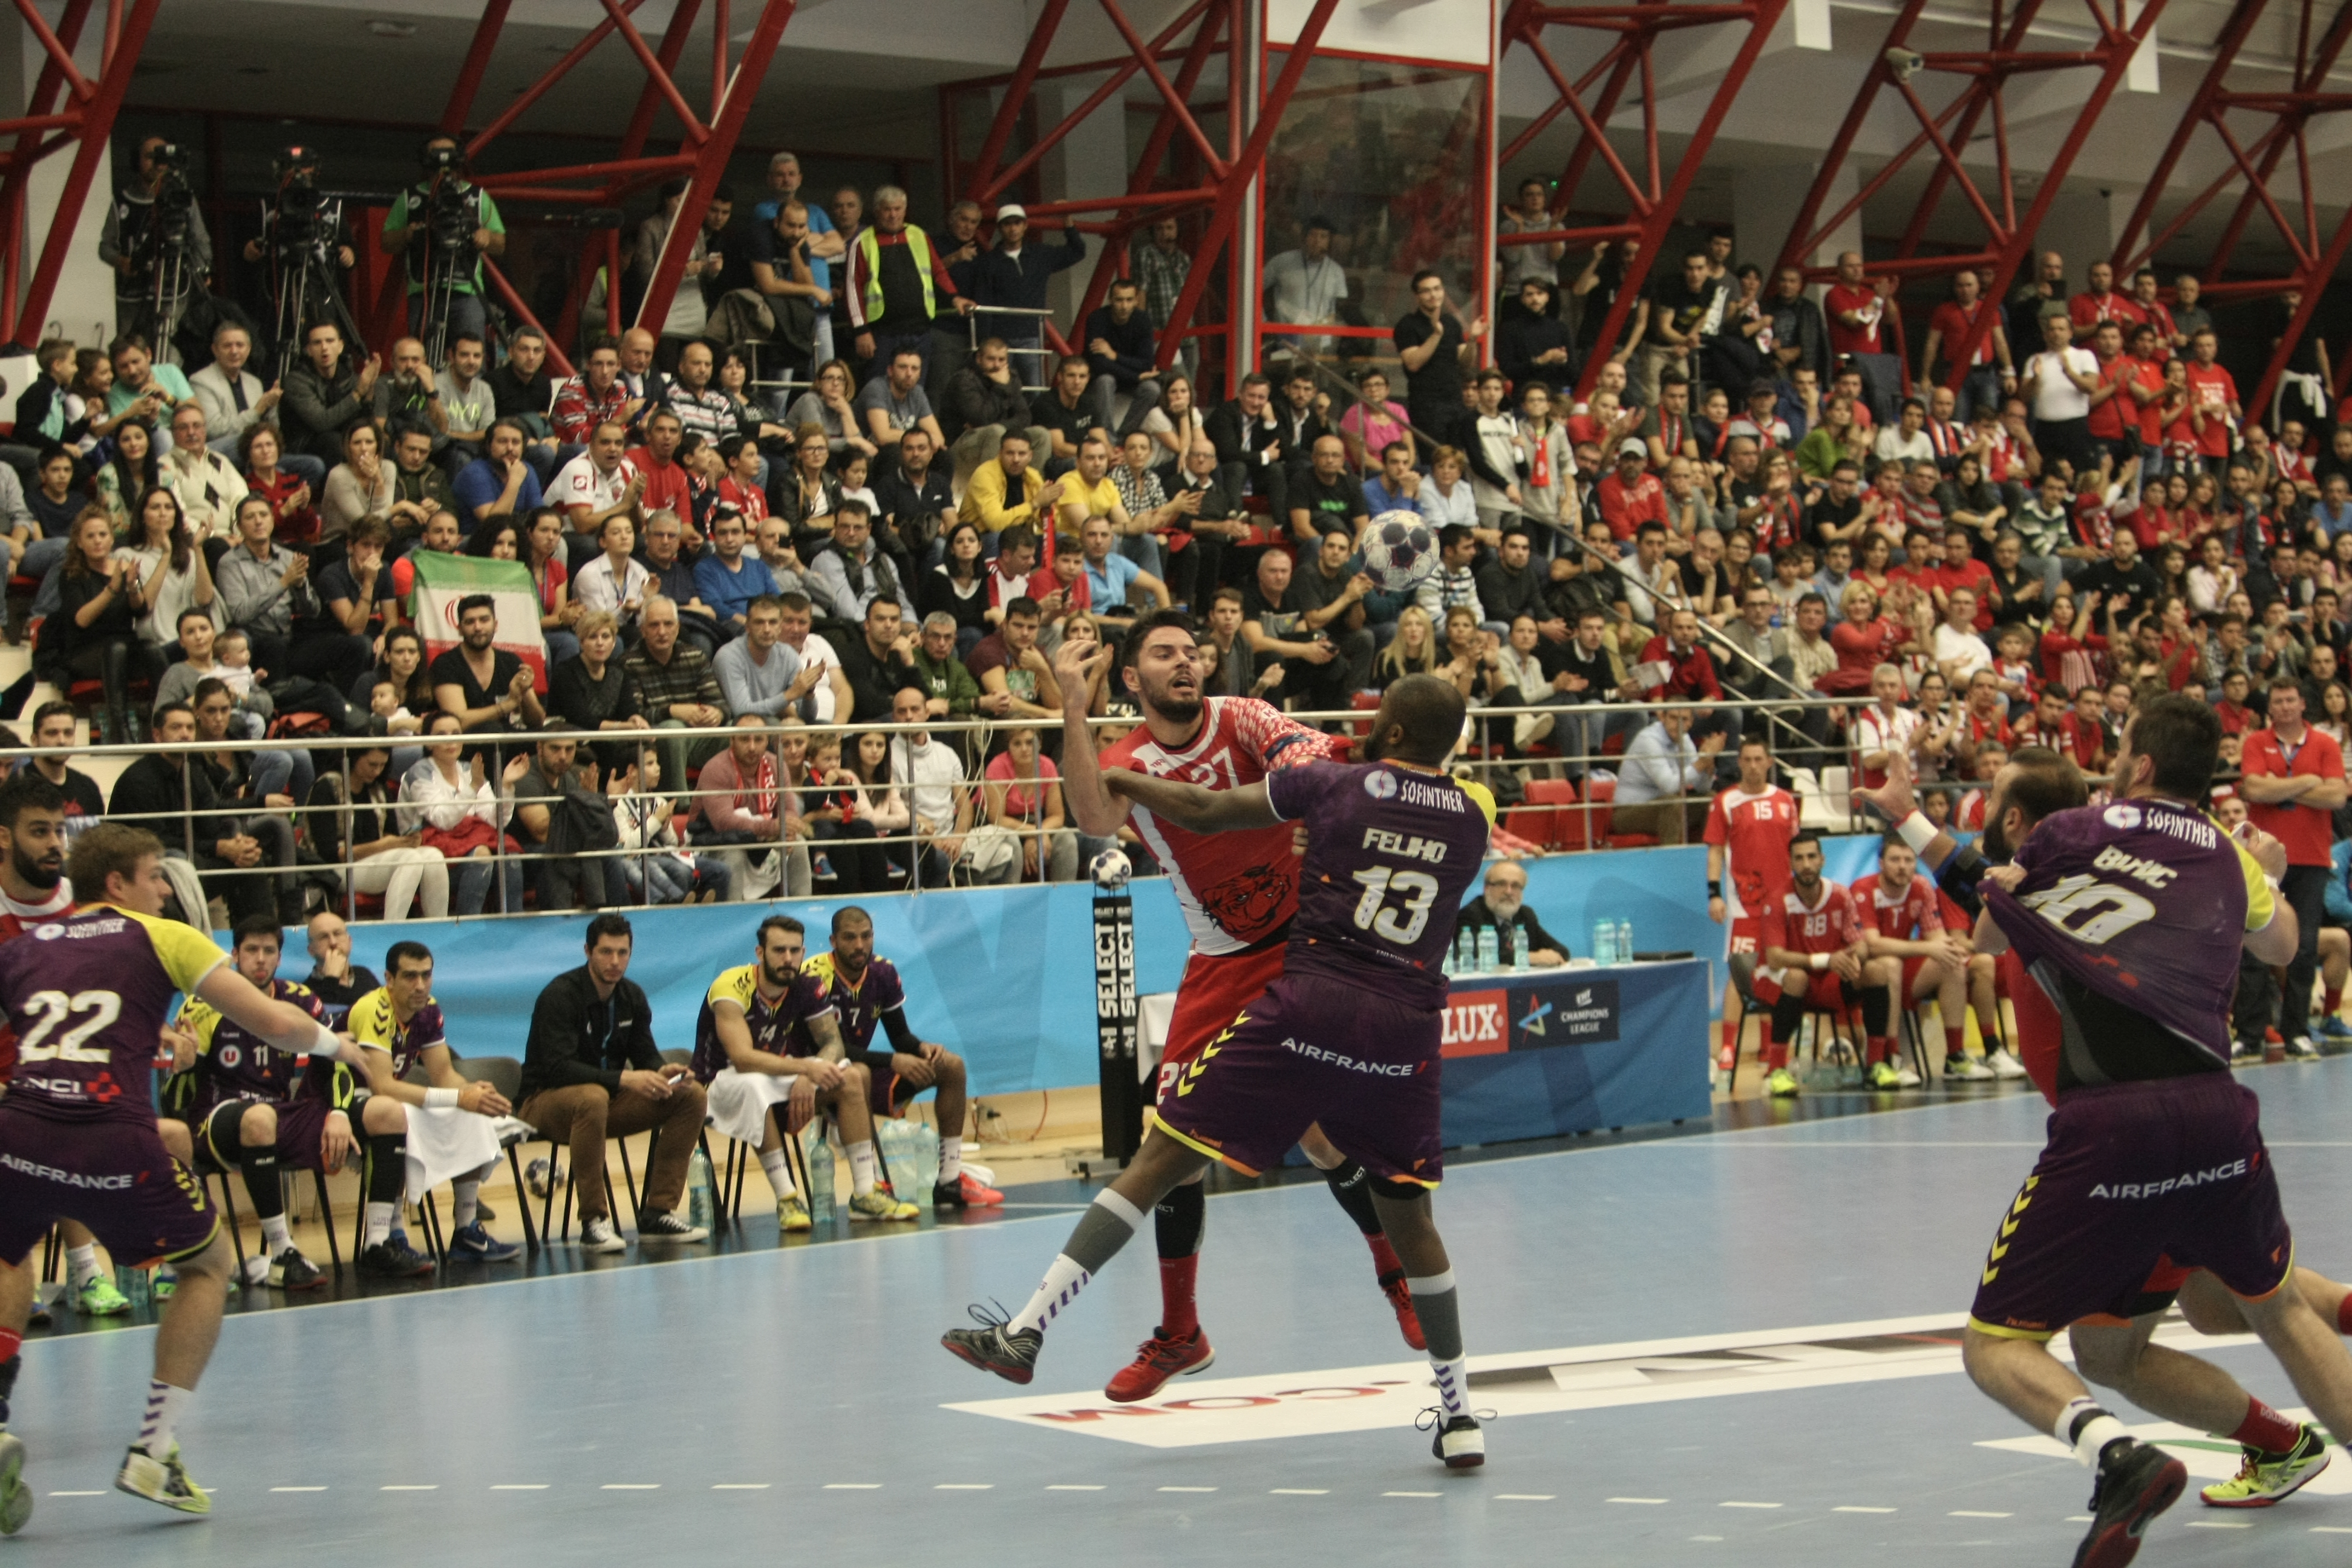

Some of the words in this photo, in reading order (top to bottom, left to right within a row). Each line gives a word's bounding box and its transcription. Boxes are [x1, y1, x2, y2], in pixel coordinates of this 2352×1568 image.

[1190, 746, 1240, 789] 27
[1400, 779, 1465, 813] SOFINTHER
[1753, 800, 1773, 820] 15
[1362, 827, 1448, 864] FELIHO
[2146, 807, 2216, 850] SOFINTHER
[1352, 864, 1439, 945] 13
[2017, 873, 2156, 945] 10
[1731, 936, 1757, 953] 15
[1094, 922, 1119, 1018] SELECT
[1117, 922, 1137, 1018] SELECT
[19, 990, 122, 1065] 22
[759, 1024, 777, 1042] 14
[849, 1007, 860, 1027] 7
[1560, 1008, 1609, 1023] CHAMPIONS
[1570, 1021, 1600, 1035] LEAGUE
[253, 1045, 269, 1067] 11
[1281, 1037, 1414, 1076] AIRFRANCE
[1156, 1062, 1189, 1106] 2
[0, 1153, 133, 1190] AIRFRANCE
[1339, 1166, 1365, 1188] SELECT
[2089, 1158, 2246, 1199] AIRFRANCE
